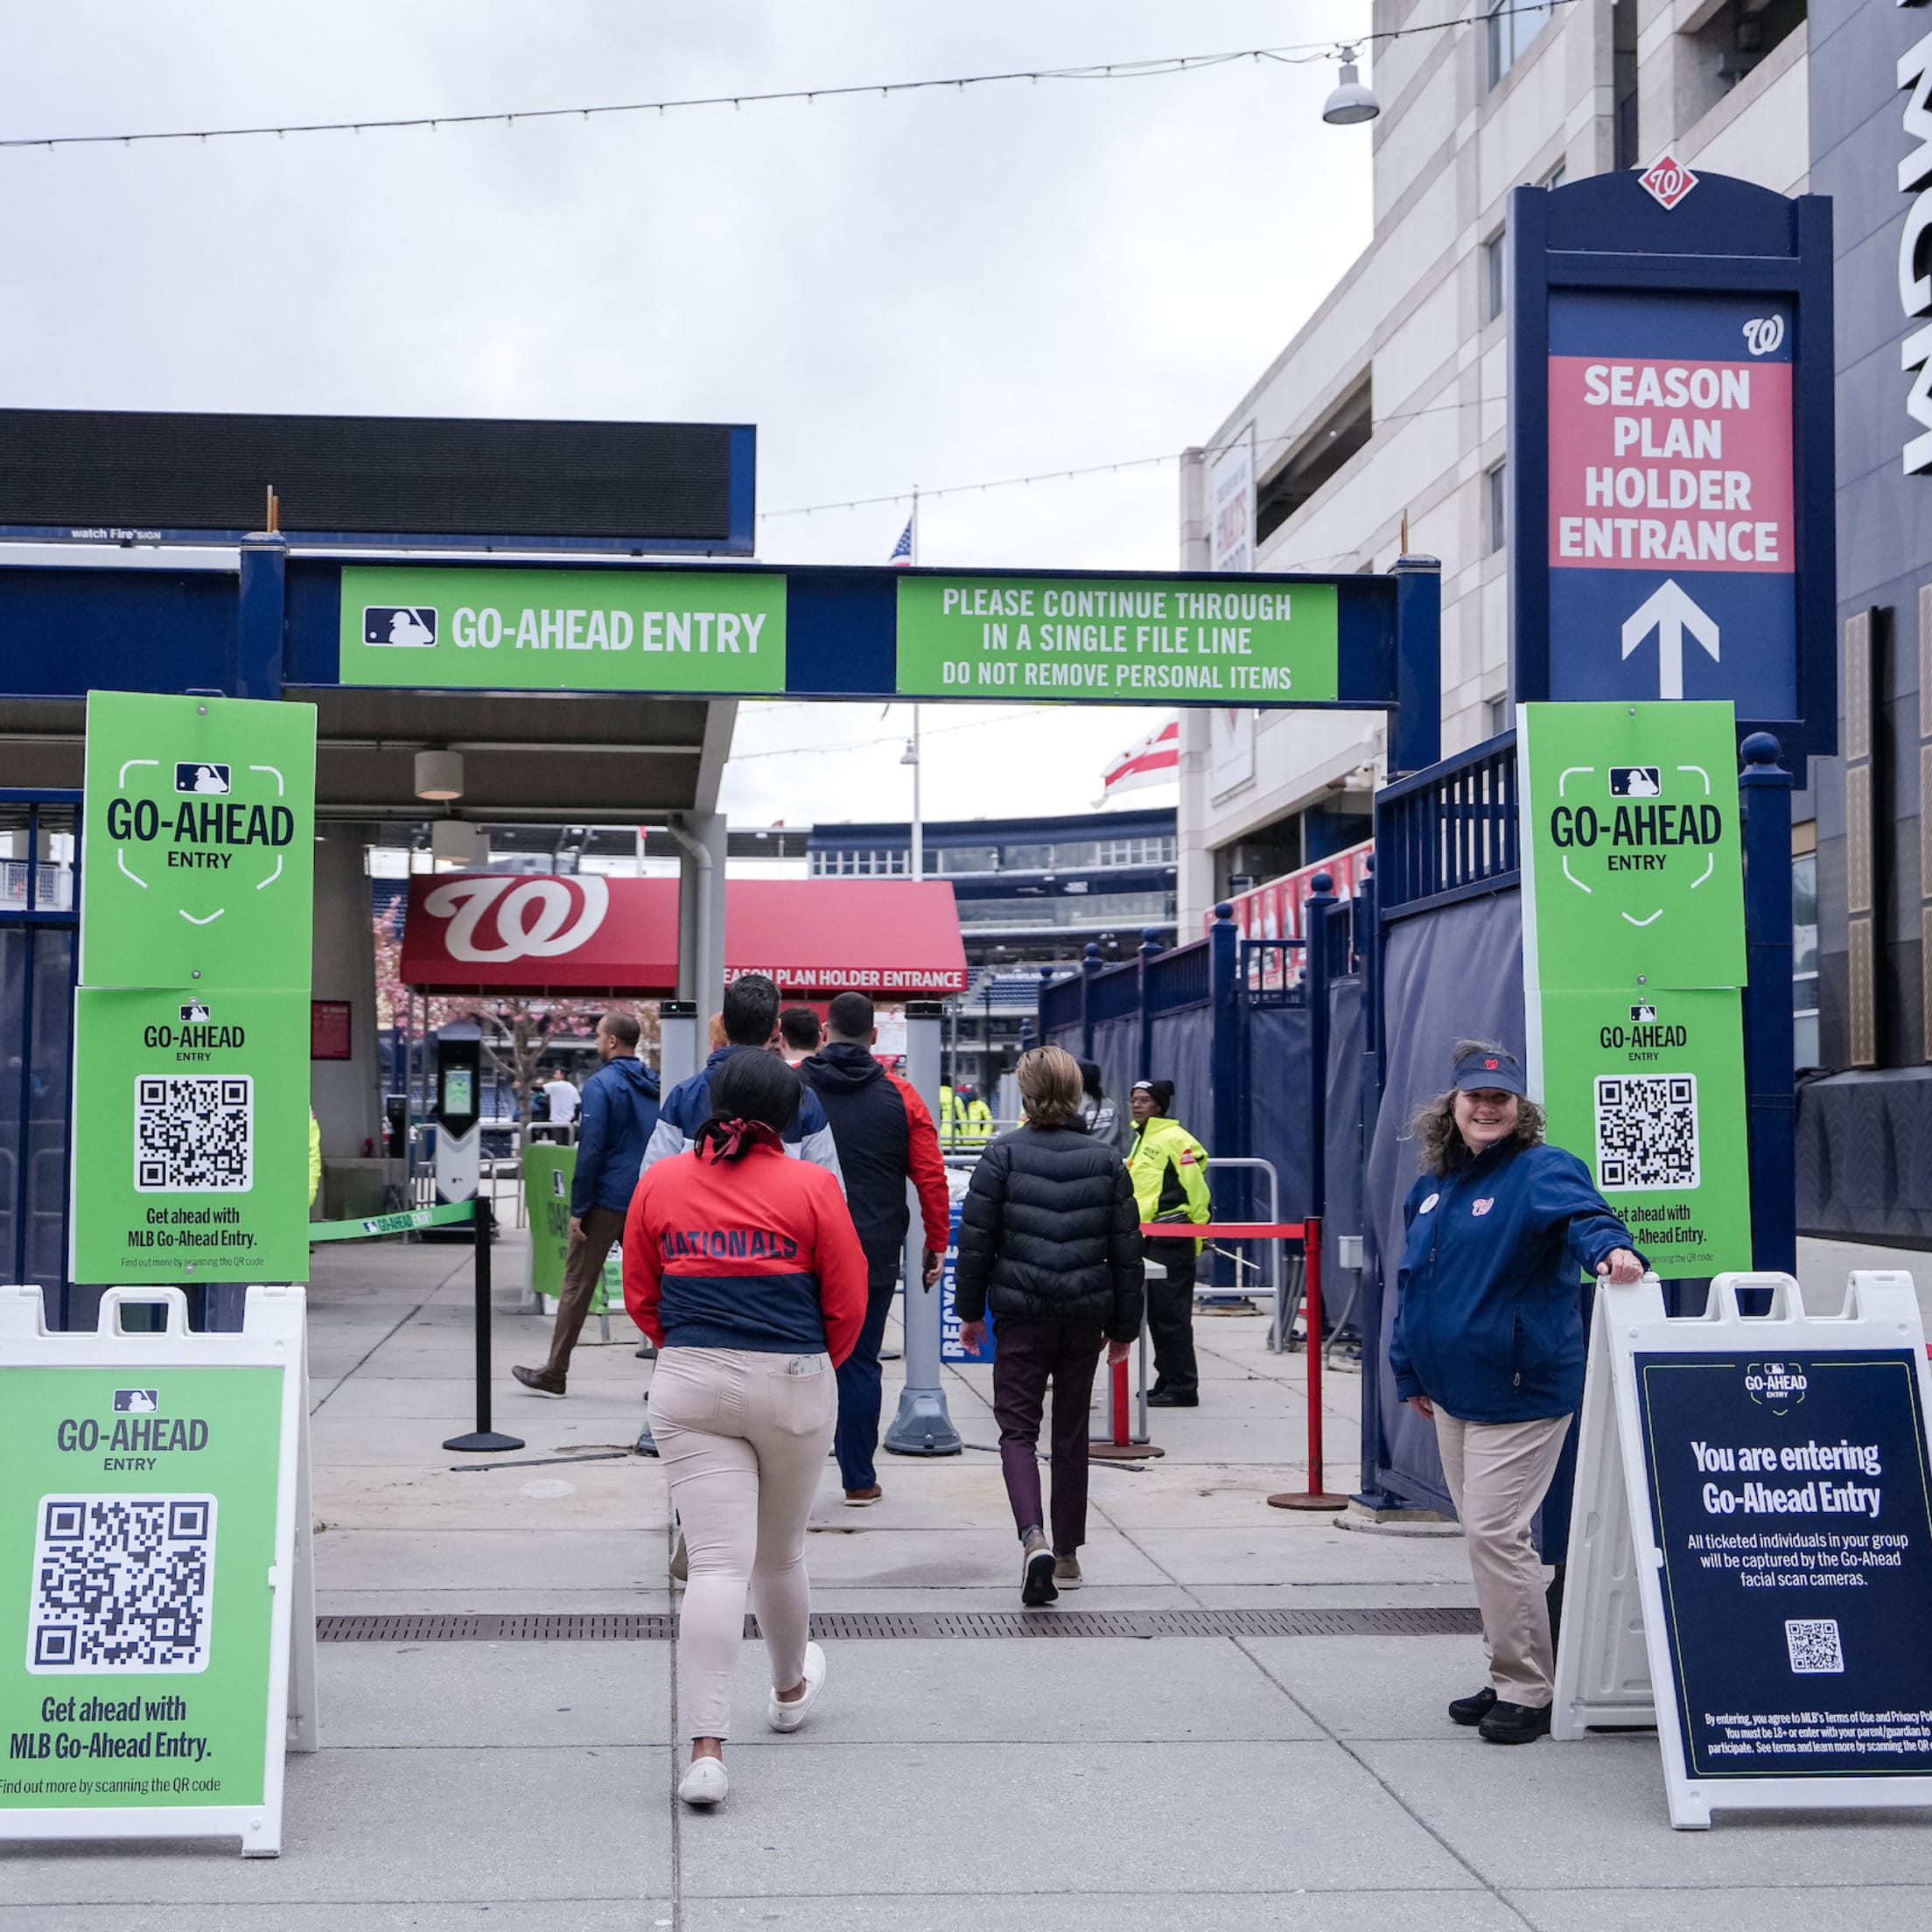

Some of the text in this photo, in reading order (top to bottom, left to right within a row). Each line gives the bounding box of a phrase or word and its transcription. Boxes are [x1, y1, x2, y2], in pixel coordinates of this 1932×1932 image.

[1584, 364, 1750, 410] SEASON
[1614, 416, 1722, 460] PLAN
[1586, 466, 1751, 512] HOLDER
[1559, 517, 1779, 563] ENTRANCE
[943, 589, 1292, 621] PLEASE CONTINUE THROUGH
[452, 607, 766, 653] GO-AHEAD ENTRY
[983, 623, 1252, 654] IN A SINGLE FILE LINE
[942, 662, 1292, 690] DO NOT REMOVE PERSONAL ITEMS
[108, 798, 294, 846] GO-AHEAD
[1550, 804, 1722, 847] GO-AHEAD
[168, 851, 232, 869] ENTRY
[1607, 854, 1667, 871] ENTRY
[776, 969, 816, 985] PLAN
[819, 970, 880, 987] HOLDER
[883, 970, 962, 988] ENTRANCE
[144, 1026, 245, 1048] GO-AHEAD
[1600, 1026, 1687, 1048] GO-AHEAD
[176, 1053, 212, 1061] ENTRY
[1628, 1052, 1659, 1061] ENTRY
[147, 1207, 239, 1224] Get ahead with
[377, 1214, 413, 1232] GO-AHEAD
[1631, 1205, 1665, 1222] ahead
[1667, 1204, 1690, 1221] with
[128, 1229, 257, 1250] MLB Go-Ahead Entry.
[660, 1230, 798, 1259] NATIONALS
[1629, 1226, 1707, 1245] -Ahead Entry.
[122, 1257, 137, 1267] Find
[139, 1257, 151, 1267] out
[174, 1257, 182, 1268] by
[220, 1256, 232, 1266] the
[234, 1256, 244, 1267] QR
[246, 1256, 264, 1266] code
[1745, 1375, 1808, 1390] GO-AHEAD
[58, 1418, 208, 1452] GO-AHEAD
[103, 1458, 157, 1471] ENTRY
[1690, 1439, 1882, 1476] You are entering
[1703, 1481, 1881, 1518] Go-Ahead Entry
[1688, 1532, 1908, 1550] All ticketed individuals in your group
[1700, 1550, 1901, 1571] will be captured by the Go-Ahead
[1740, 1572, 1868, 1587] facial scan cameras.
[41, 1695, 186, 1722] Get ahead with
[1704, 1712, 1715, 1726] By
[1716, 1712, 1752, 1726] entering,
[1753, 1714, 1767, 1726] you
[1768, 1714, 1791, 1726] agree
[1791, 1712, 1800, 1724] to
[1824, 1712, 1850, 1723] Terms
[1850, 1711, 1858, 1723] of
[1858, 1711, 1875, 1723] Use
[1875, 1711, 1890, 1723] and
[1891, 1711, 1920, 1725] Privacy
[1725, 1725, 1931, 1740] You must be 18+ or enter with your parent/guardian to
[10, 1732, 213, 1762] MLB Go-Ahead Entry.
[1708, 1740, 1929, 1756] participate. See terms and learn more by scanning the QR
[24, 1779, 44, 1794] out
[46, 1782, 77, 1793] more
[79, 1779, 94, 1796] by
[95, 1778, 150, 1795] scanning
[151, 1777, 171, 1792] the
[173, 1777, 190, 1793] QR
[192, 1777, 221, 1792] code
